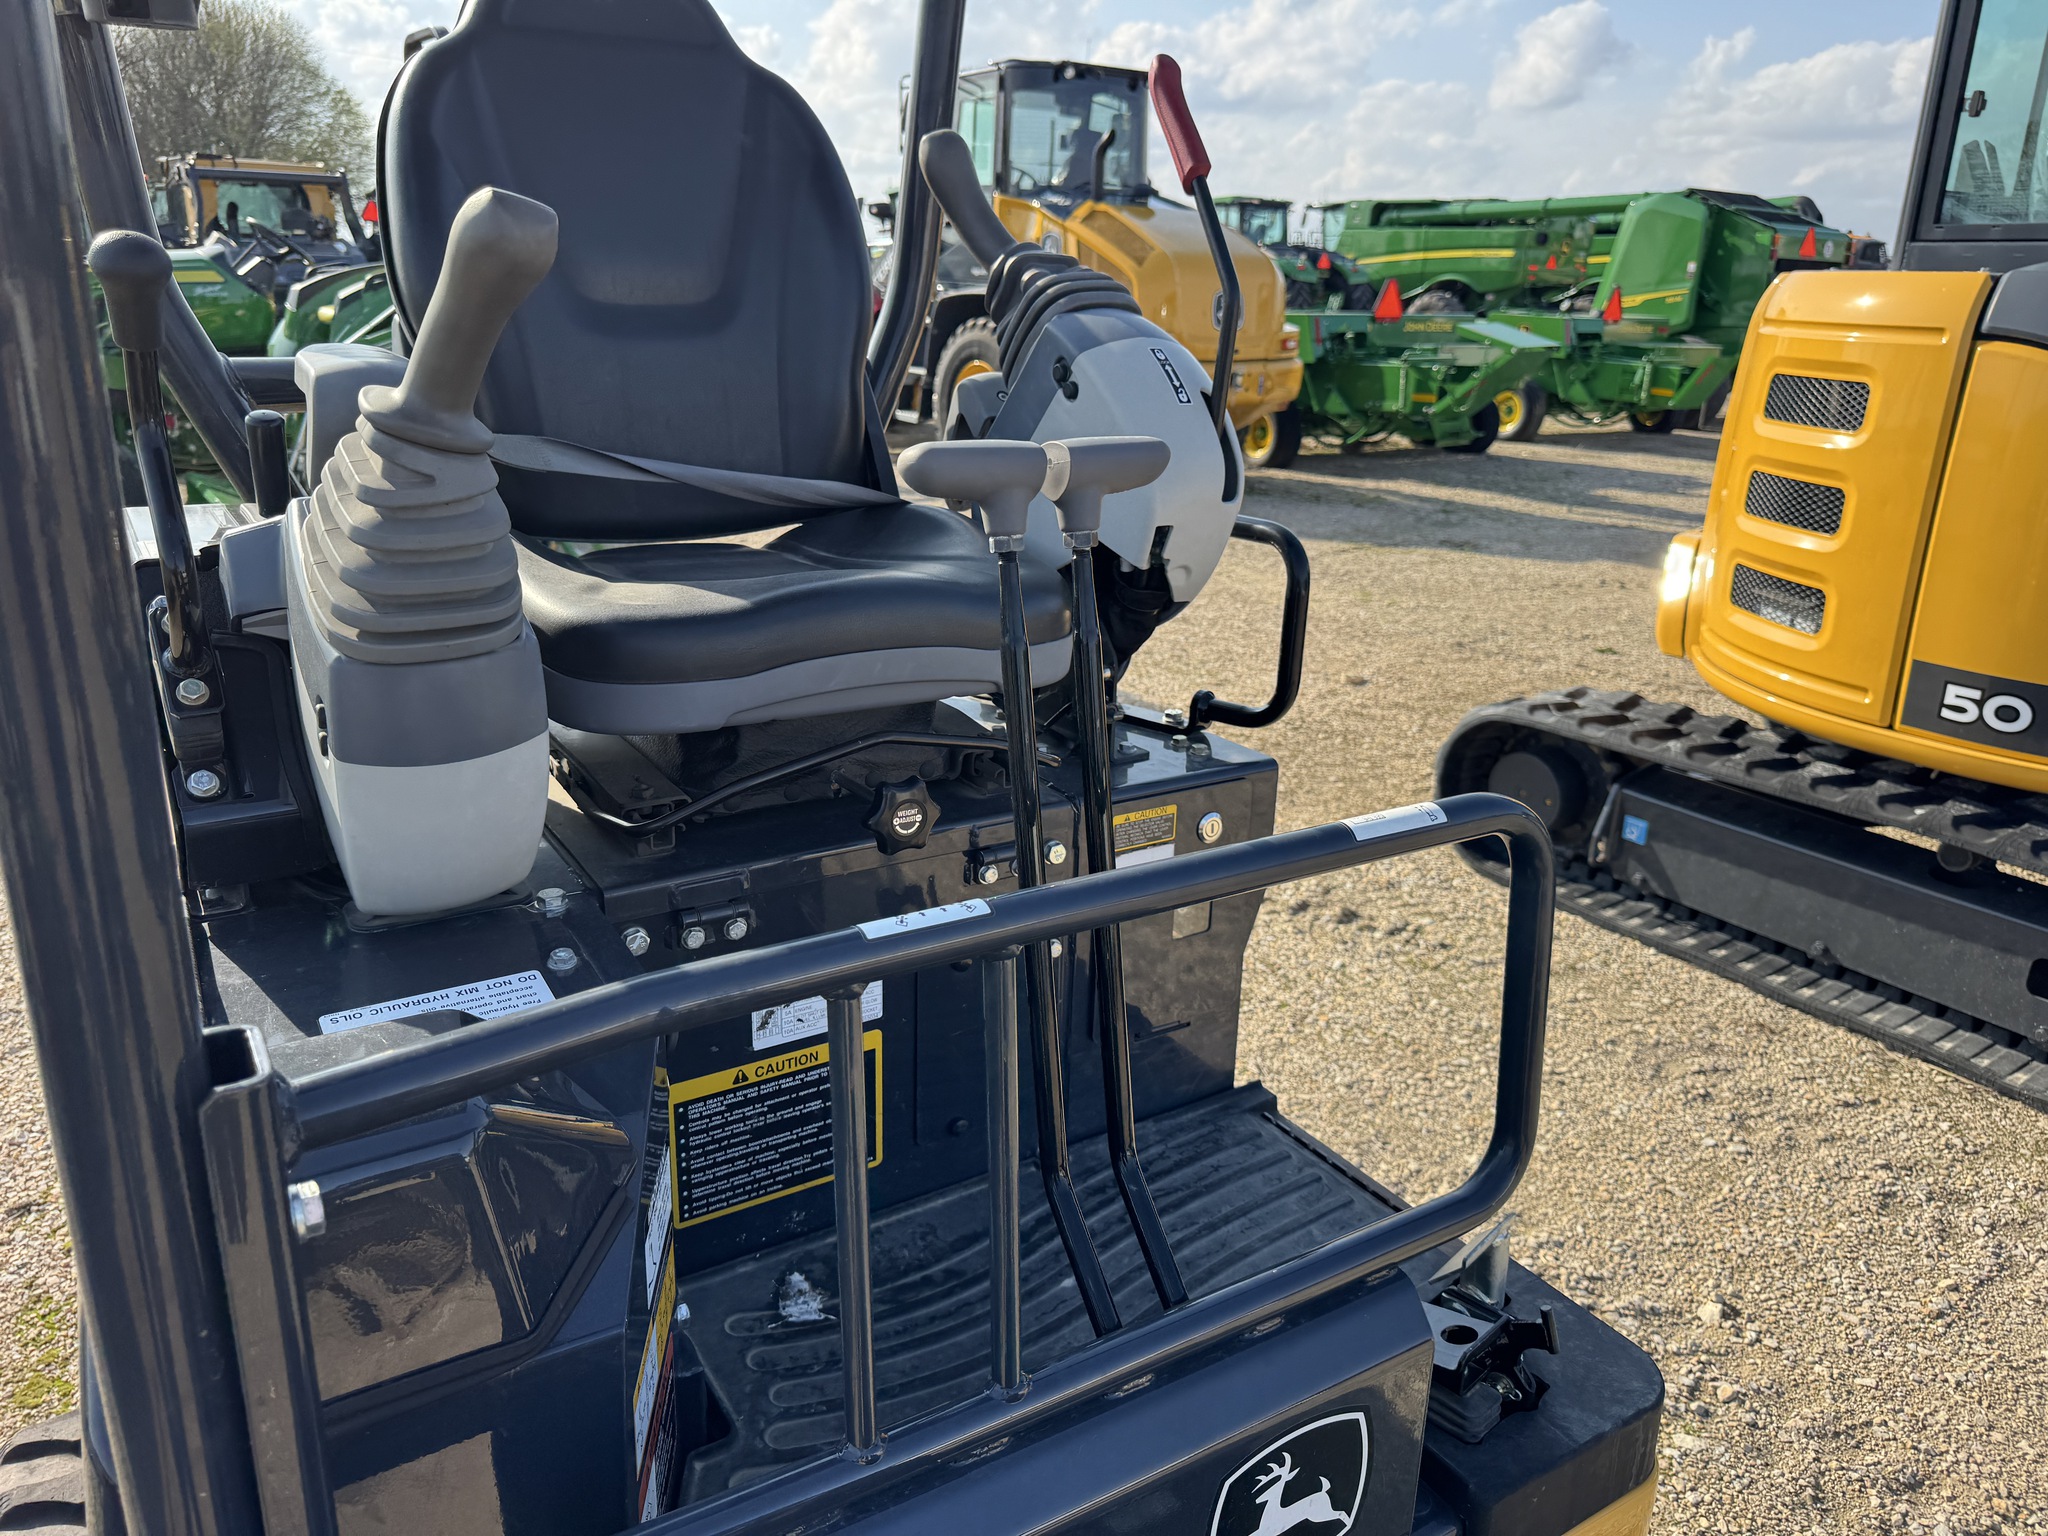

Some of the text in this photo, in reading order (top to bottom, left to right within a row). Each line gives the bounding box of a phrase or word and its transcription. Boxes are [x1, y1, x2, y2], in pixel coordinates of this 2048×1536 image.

[1940, 683, 2033, 733] 50
[898, 808, 918, 817] WEIGHT
[1134, 807, 1168, 820] CAUTION
[900, 816, 916, 824] ADJUST
[518, 974, 537, 983] DO
[486, 980, 512, 990] NOT
[455, 987, 479, 996] MIX
[489, 985, 533, 998] acceptable
[516, 992, 537, 1000] chart
[370, 993, 450, 1016] HYDRAULIC
[440, 996, 485, 1008] alternative
[479, 1004, 520, 1016] Hydraulic
[330, 1012, 362, 1024] OILS
[756, 1051, 818, 1076] CAUTION
